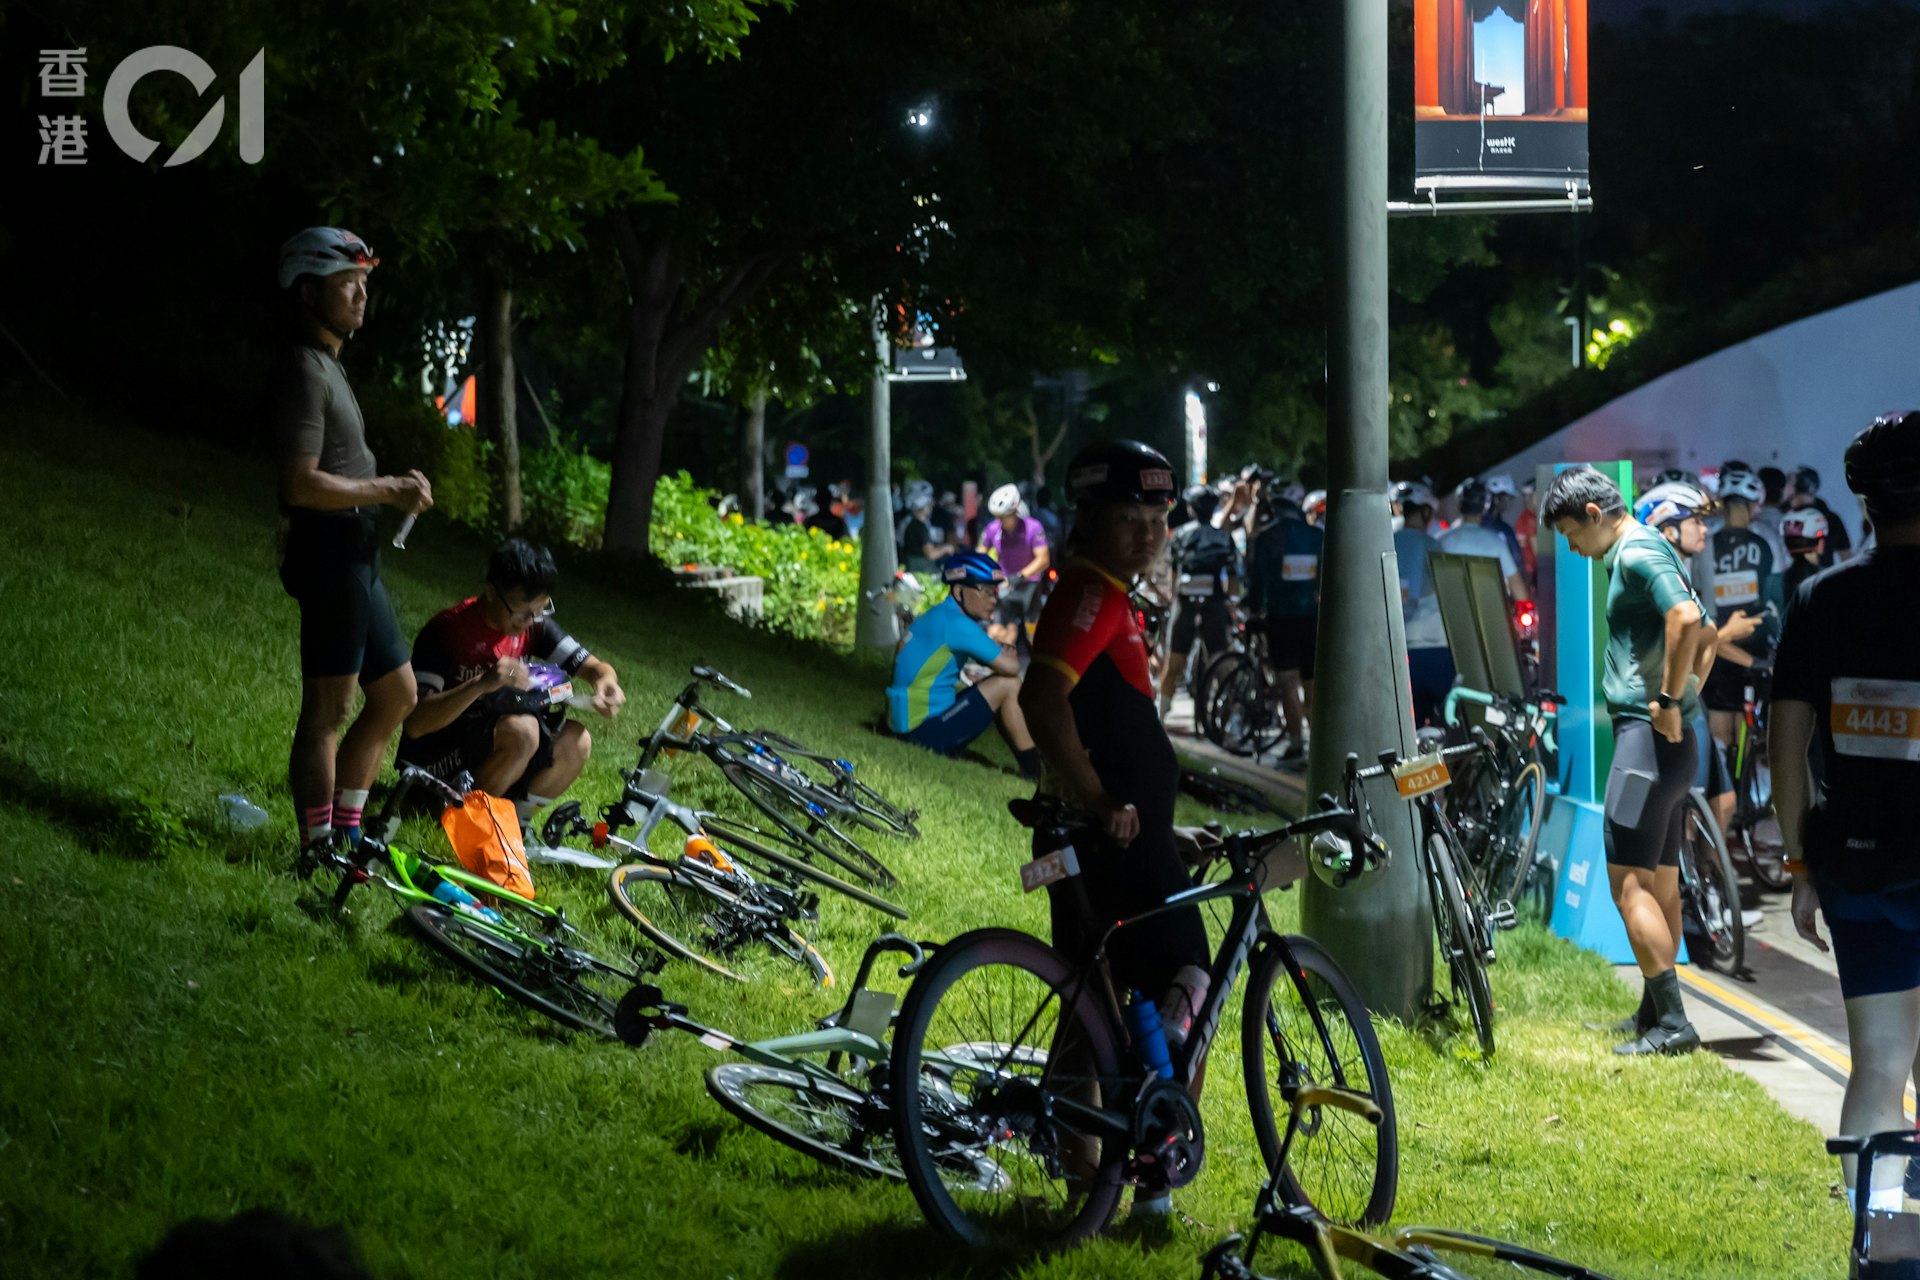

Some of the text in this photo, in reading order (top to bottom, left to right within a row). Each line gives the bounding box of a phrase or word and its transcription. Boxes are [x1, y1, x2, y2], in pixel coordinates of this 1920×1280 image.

[1845, 708, 1908, 735] 4443
[1407, 768, 1440, 791] 4214
[1023, 858, 1064, 887] 2327
